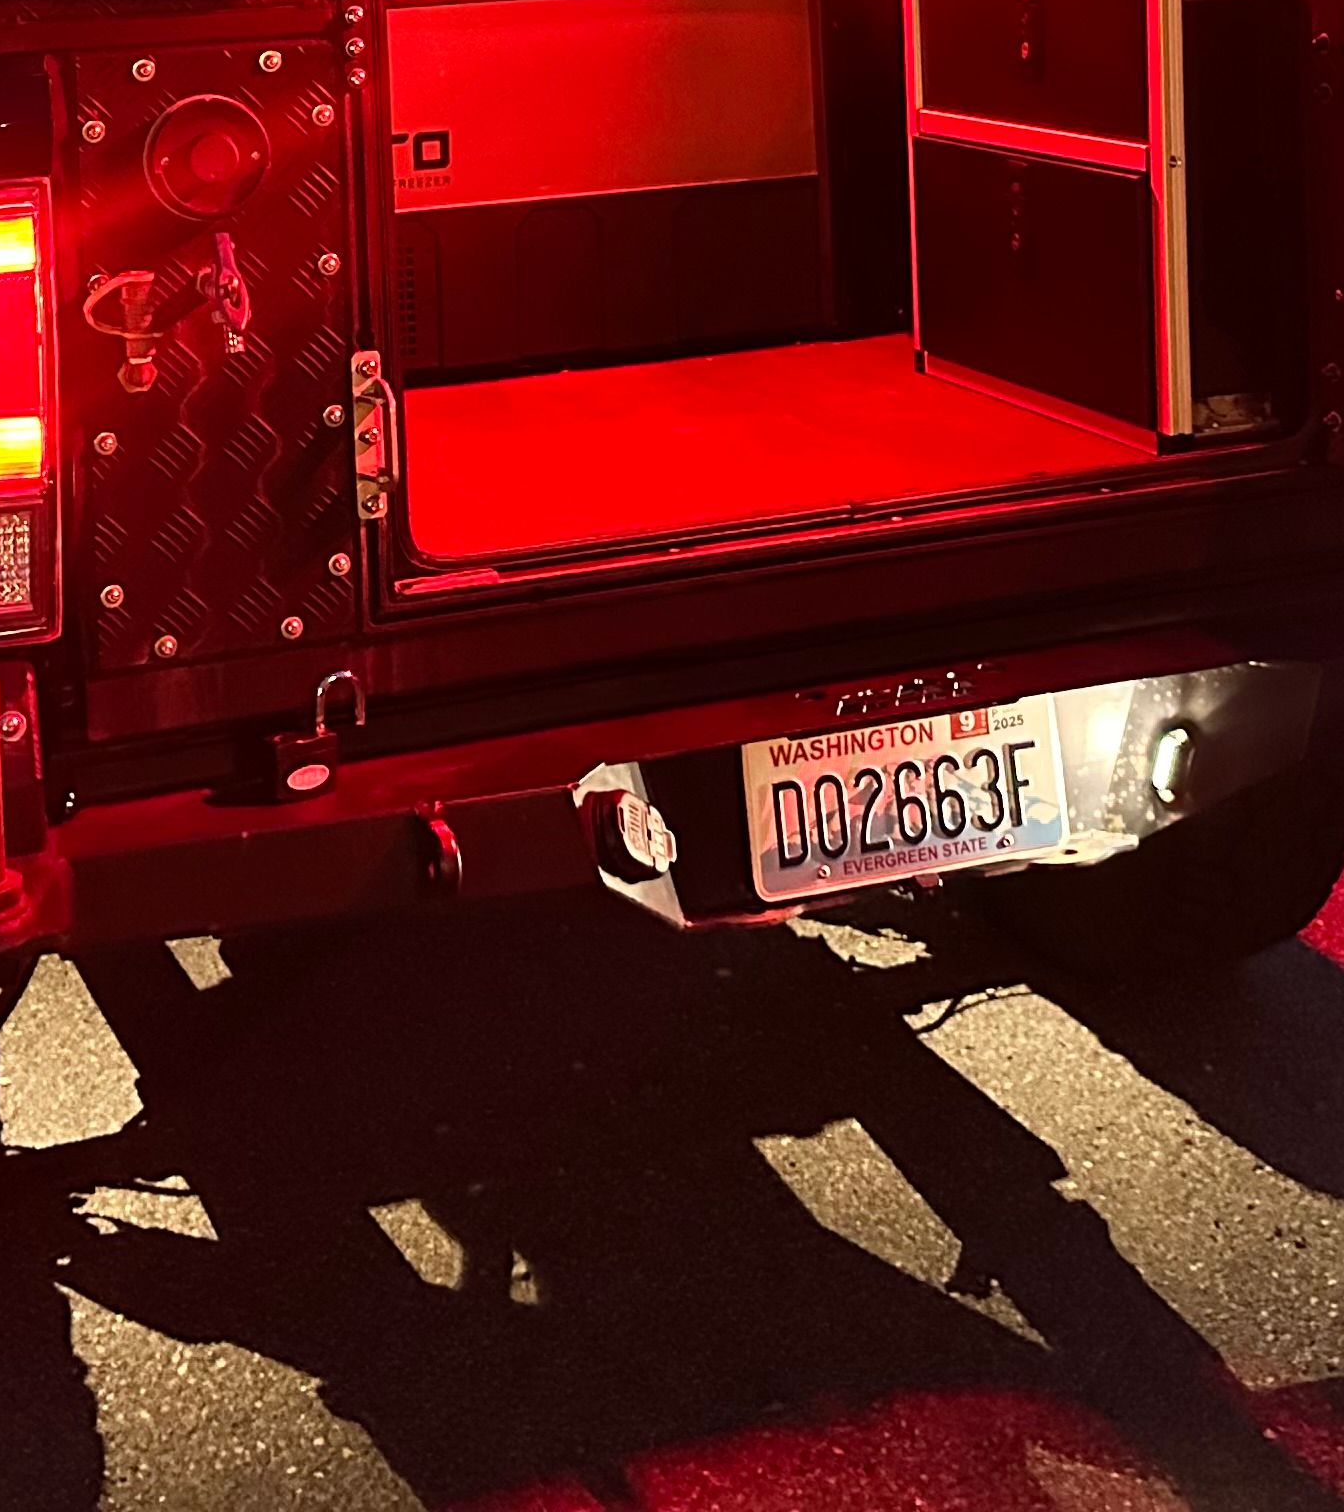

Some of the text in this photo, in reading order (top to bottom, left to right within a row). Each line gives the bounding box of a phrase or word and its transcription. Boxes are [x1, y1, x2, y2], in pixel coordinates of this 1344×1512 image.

[394, 175, 452, 189] REEZER
[959, 710, 976, 732] 9
[992, 714, 1025, 731] 2025
[769, 720, 934, 767] WASHINGTON
[771, 740, 1036, 869] D02663F
[842, 836, 988, 876] EVERGREEN STATE
